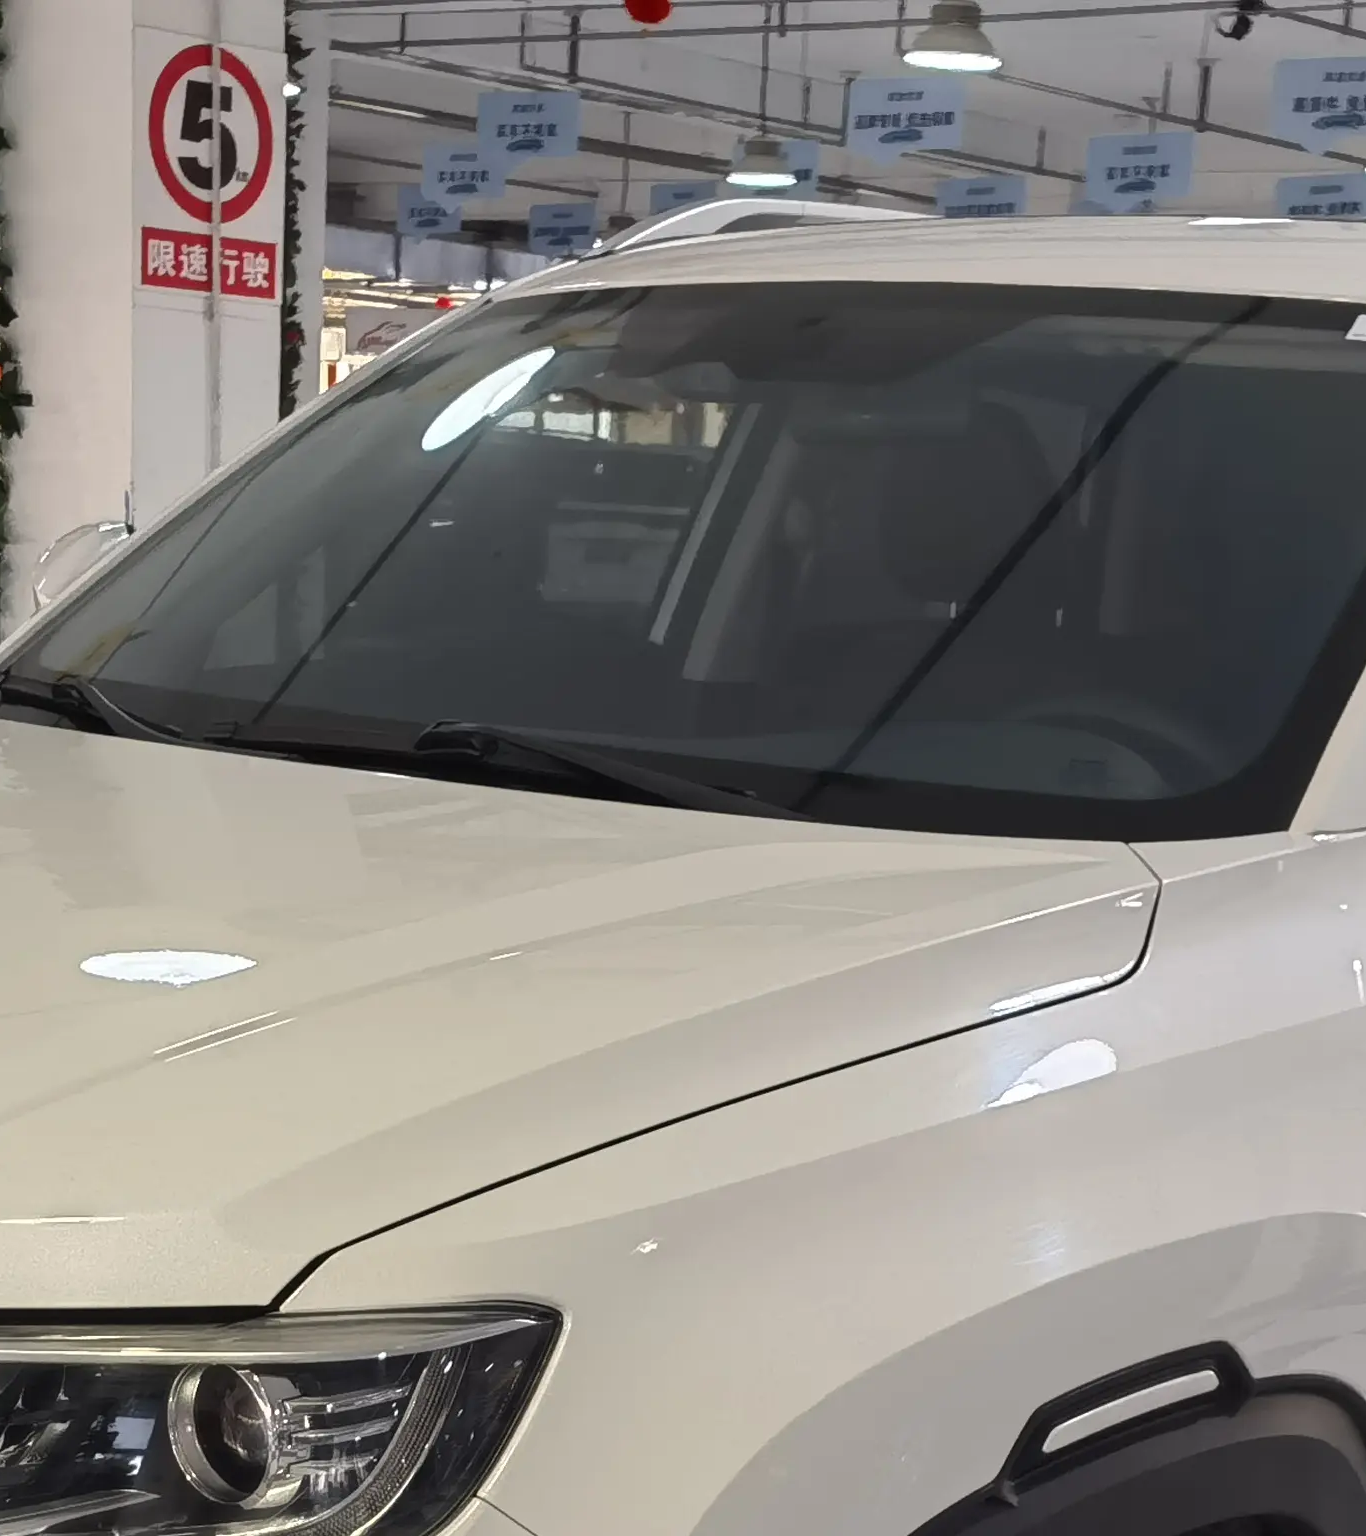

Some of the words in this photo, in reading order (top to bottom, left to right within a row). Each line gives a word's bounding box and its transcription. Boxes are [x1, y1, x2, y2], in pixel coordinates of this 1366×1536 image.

[176, 79, 238, 191] 5
[146, 238, 270, 289] 限速行驶
